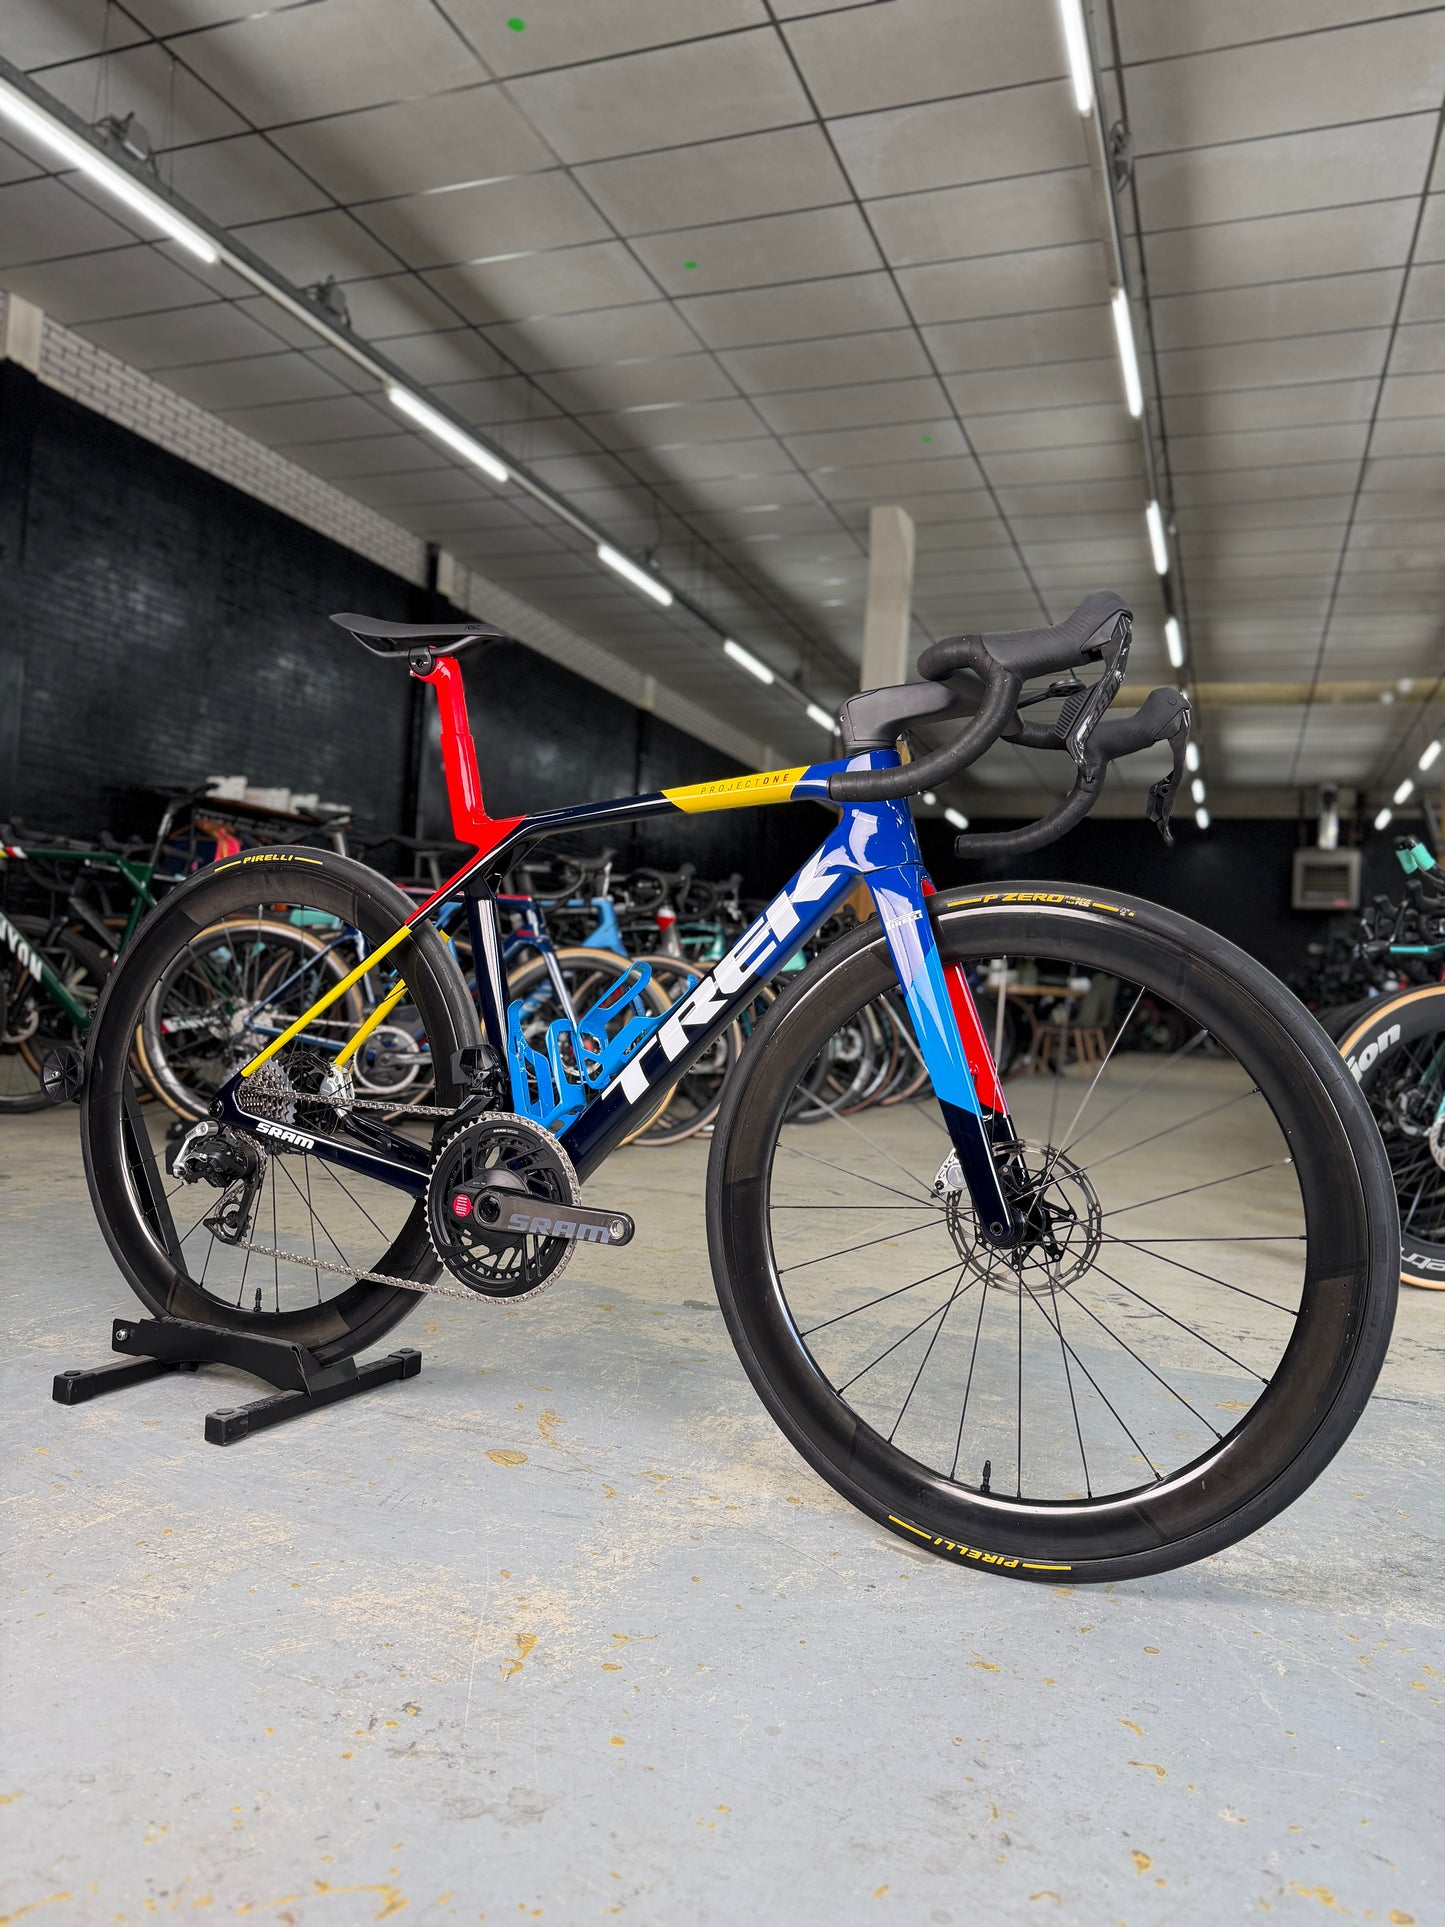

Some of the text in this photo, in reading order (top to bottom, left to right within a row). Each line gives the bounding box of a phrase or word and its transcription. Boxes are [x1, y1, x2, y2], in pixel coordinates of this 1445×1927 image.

[243, 853, 294, 864] PIRELLI
[982, 892, 1065, 904] P ZERO
[601, 844, 841, 1105] TREK
[255, 1122, 315, 1150] SRAM
[507, 1213, 610, 1244] SRAM
[1400, 1246, 1445, 1272] etr
[933, 1537, 1020, 1568] PIRELLI
